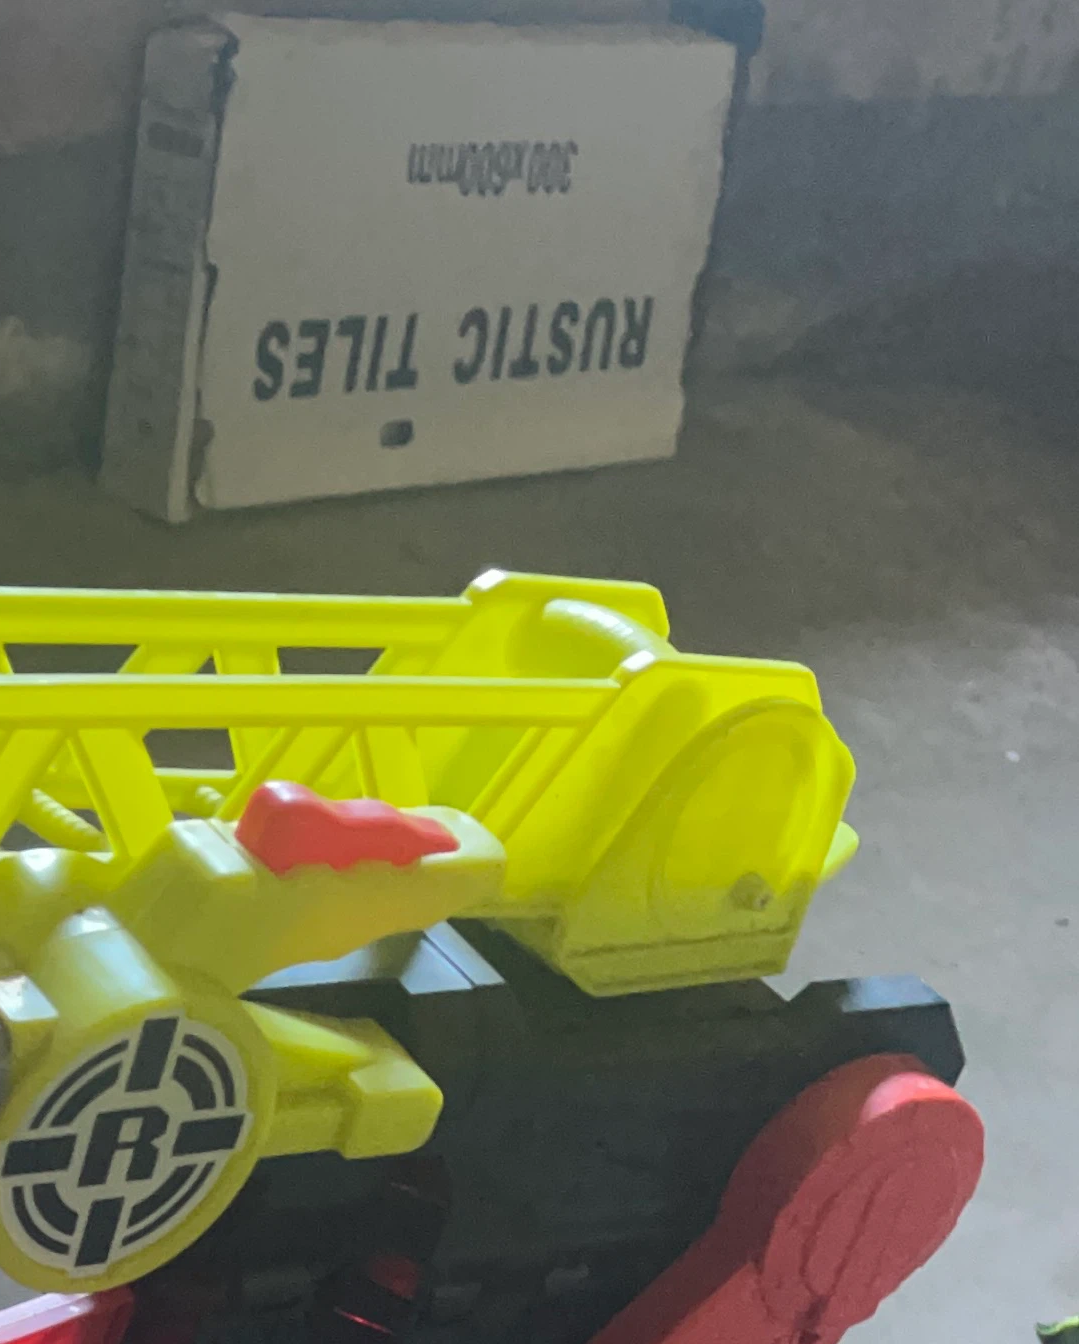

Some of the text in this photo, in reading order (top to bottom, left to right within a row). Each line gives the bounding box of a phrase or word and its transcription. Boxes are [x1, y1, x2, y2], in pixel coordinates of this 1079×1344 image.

[253, 296, 654, 401] RUSTIC TILES
[77, 1105, 170, 1187] R
